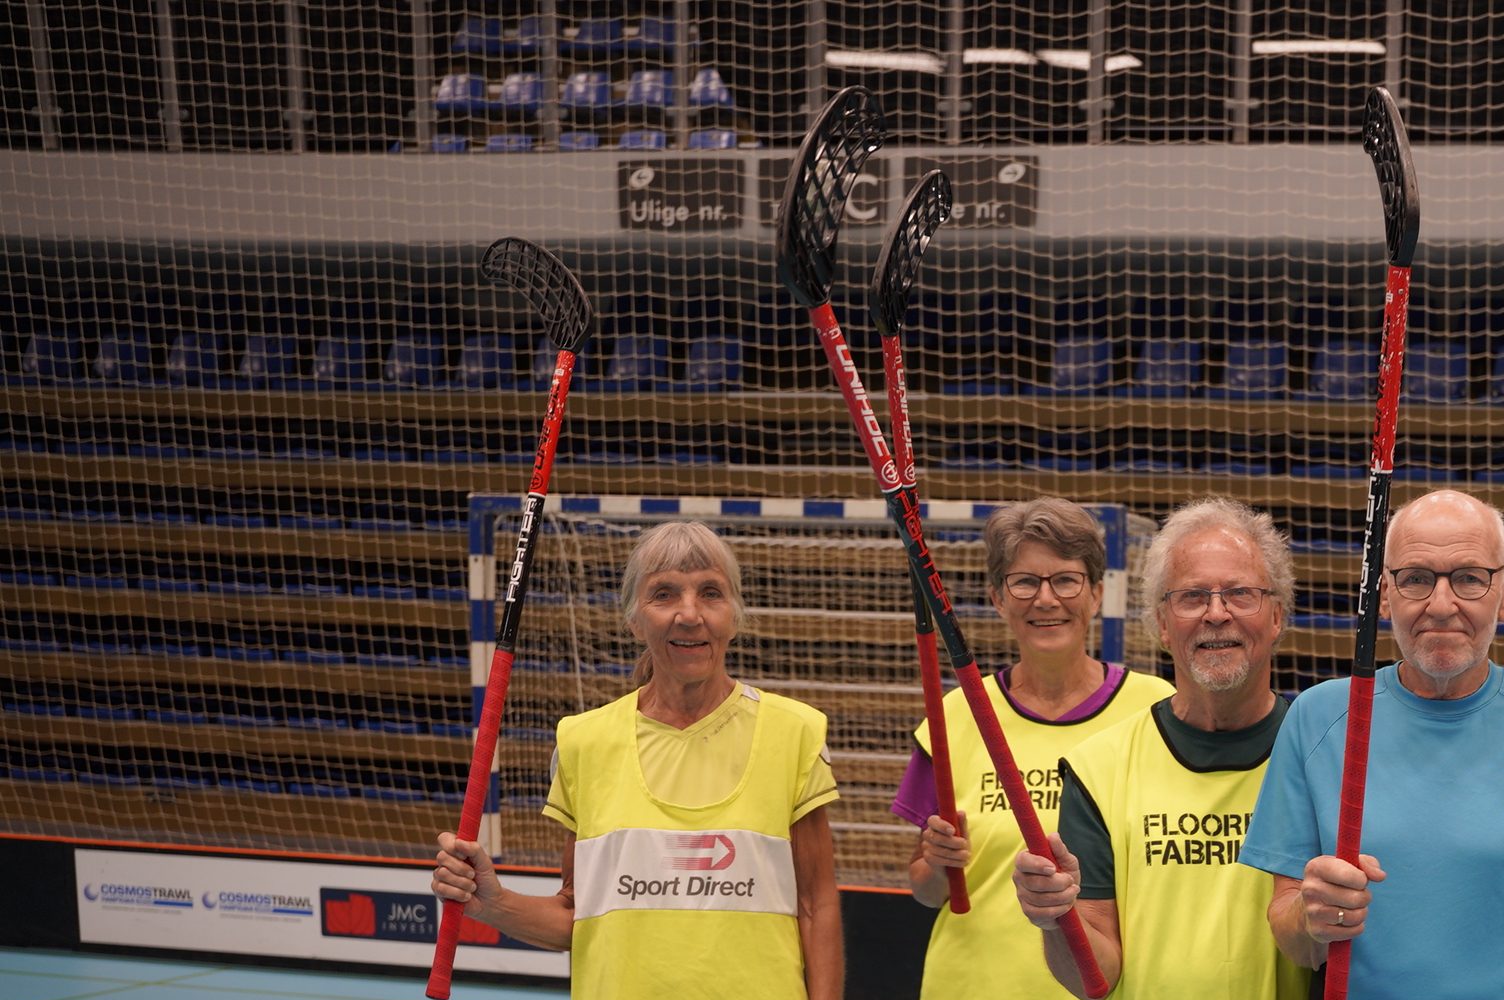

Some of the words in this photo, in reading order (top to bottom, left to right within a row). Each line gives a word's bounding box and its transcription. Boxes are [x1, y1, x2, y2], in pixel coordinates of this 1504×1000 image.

[631, 201, 689, 226] Ulige
[699, 204, 728, 221] nr.
[975, 203, 1006, 220] nr.
[836, 343, 891, 458] UNIHOC
[505, 498, 538, 603] FIGHTER
[980, 789, 1060, 814] FARI
[101, 884, 193, 900] COSMOSTRAWL
[617, 874, 681, 900] Sport
[686, 875, 755, 897] Direct
[219, 892, 313, 908] COSMOSTRAWL
[387, 903, 427, 923] JMC
[382, 922, 433, 934] INVEST
